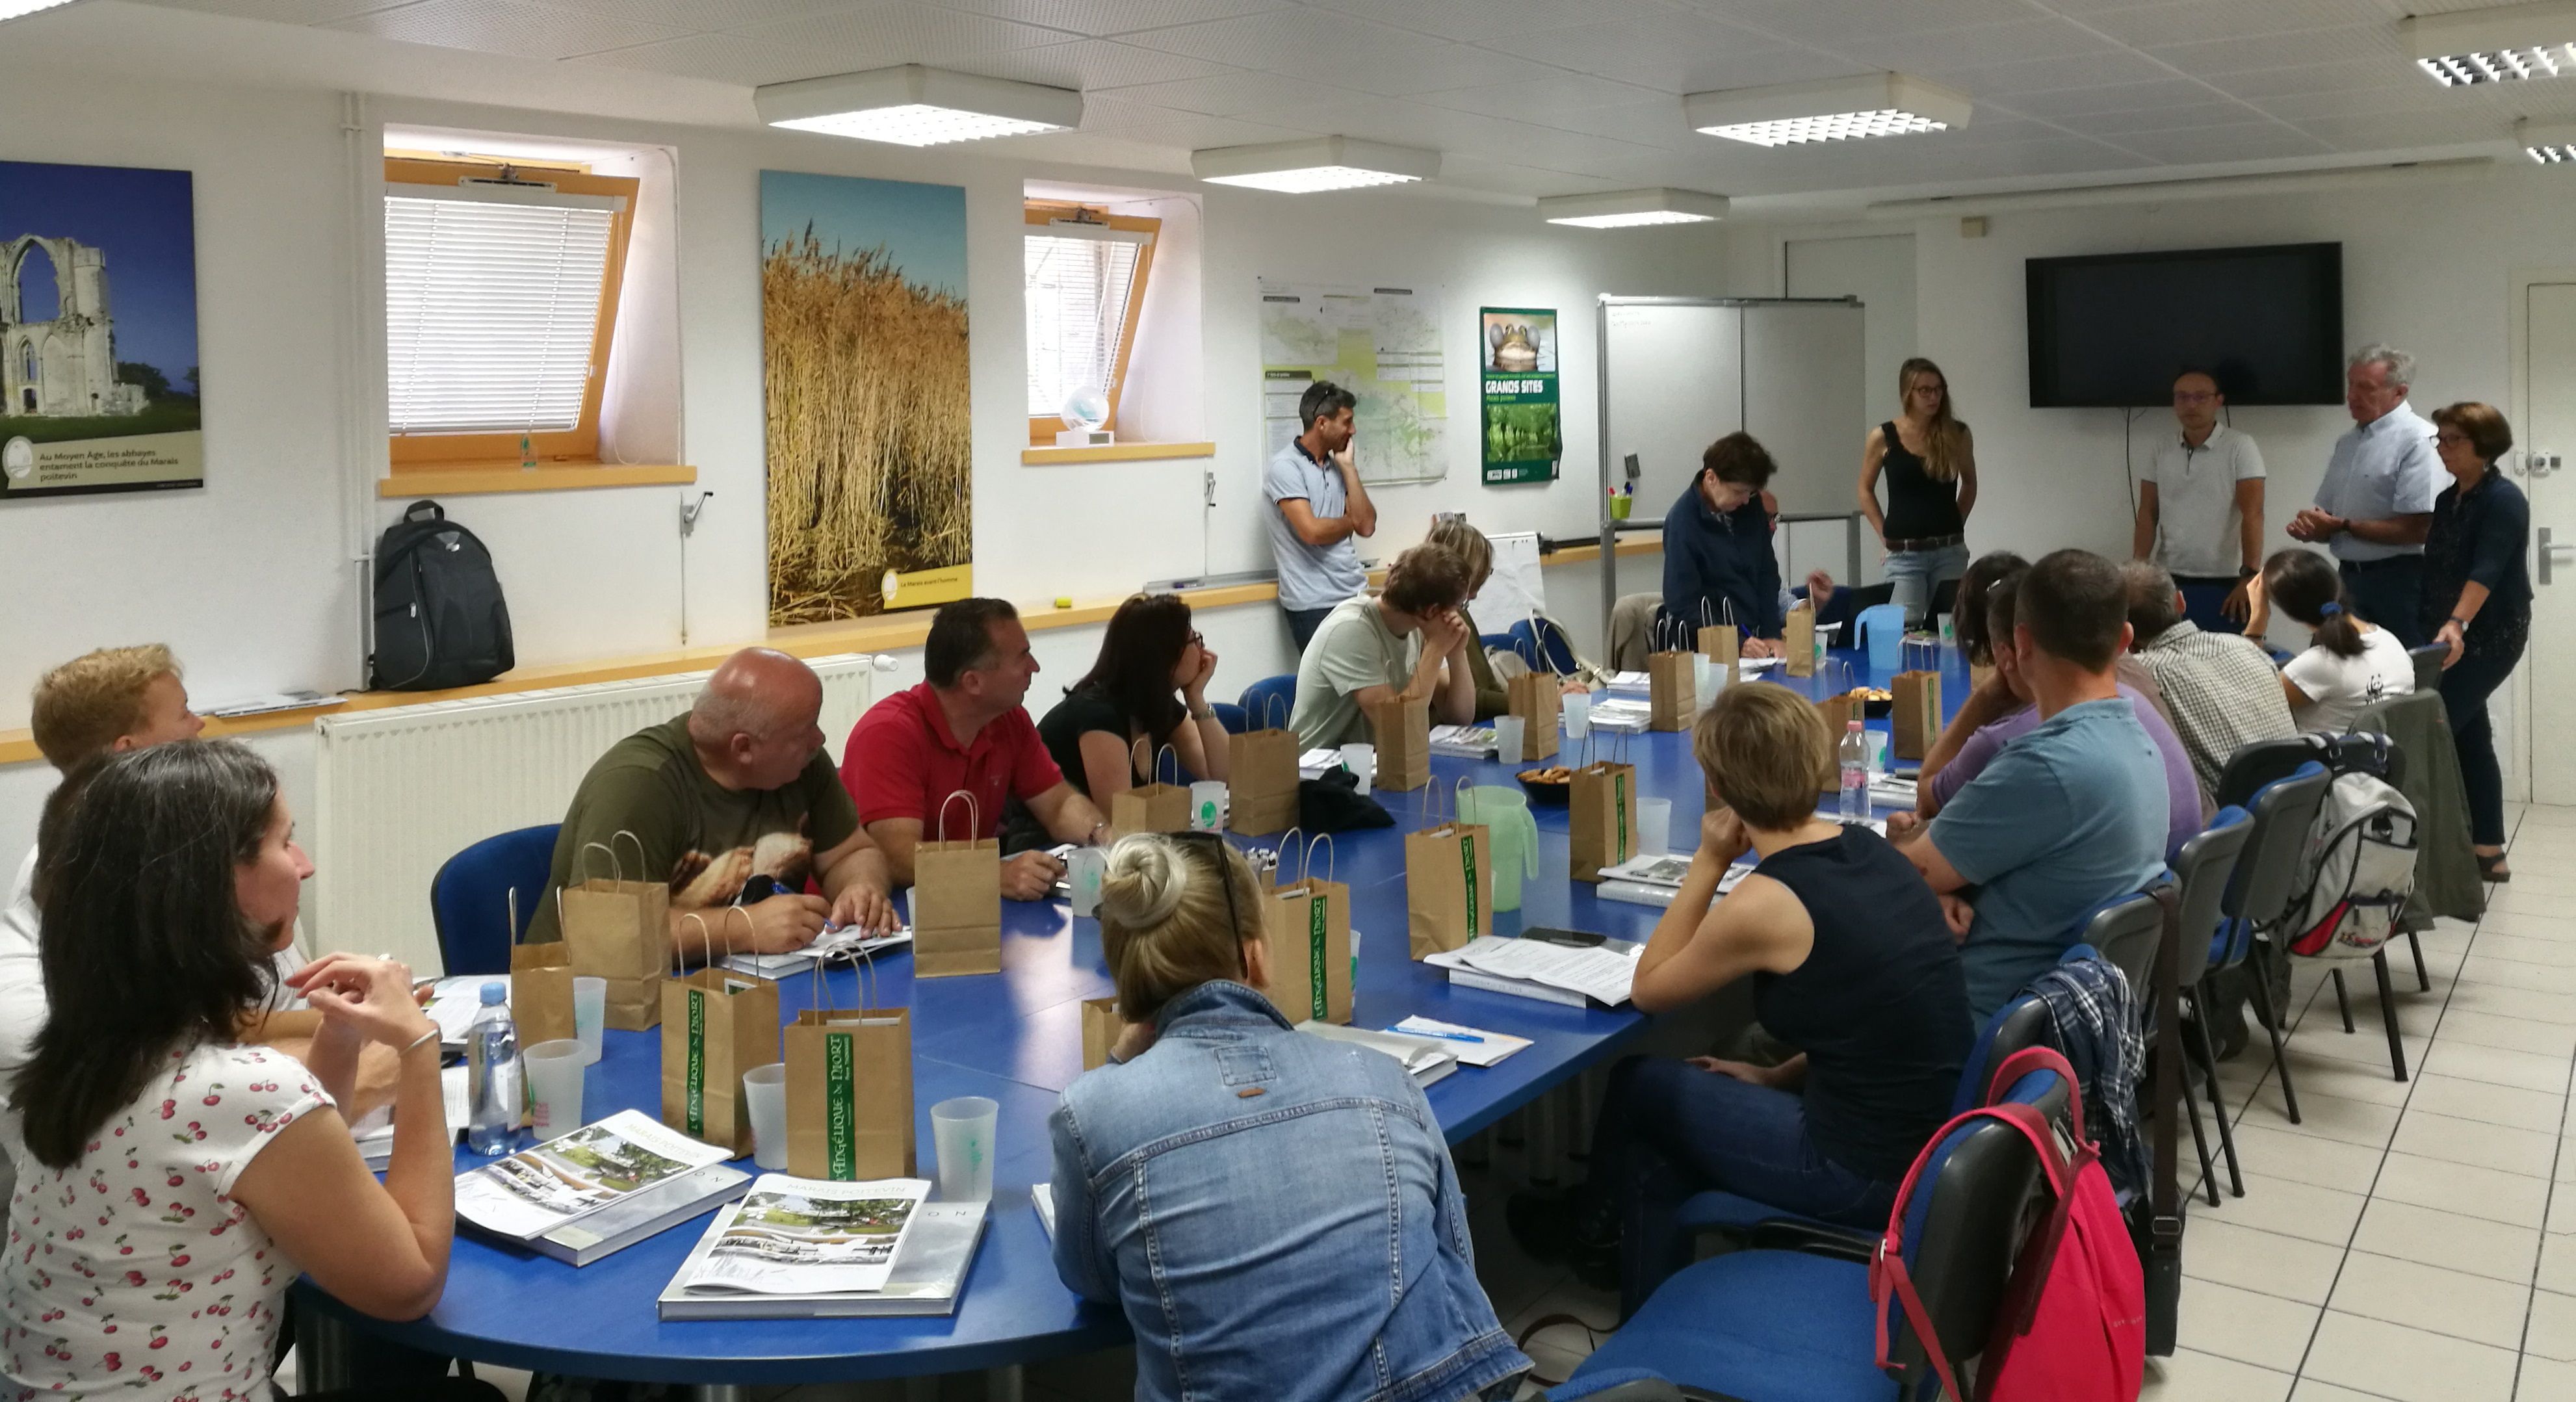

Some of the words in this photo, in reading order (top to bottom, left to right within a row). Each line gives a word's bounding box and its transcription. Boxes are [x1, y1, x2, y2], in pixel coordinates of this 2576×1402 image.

[1485, 380, 1519, 394] GRANDS
[1521, 379, 1543, 393] SITES
[54, 452, 85, 461] Moyen
[107, 450, 119, 458] les
[121, 449, 156, 460] abbayes
[39, 462, 82, 471] entament
[94, 458, 135, 469] conquête
[137, 458, 149, 466] du
[150, 457, 179, 465] Marais
[40, 473, 77, 483] poitevin
[830, 1035, 843, 1082] NIORT
